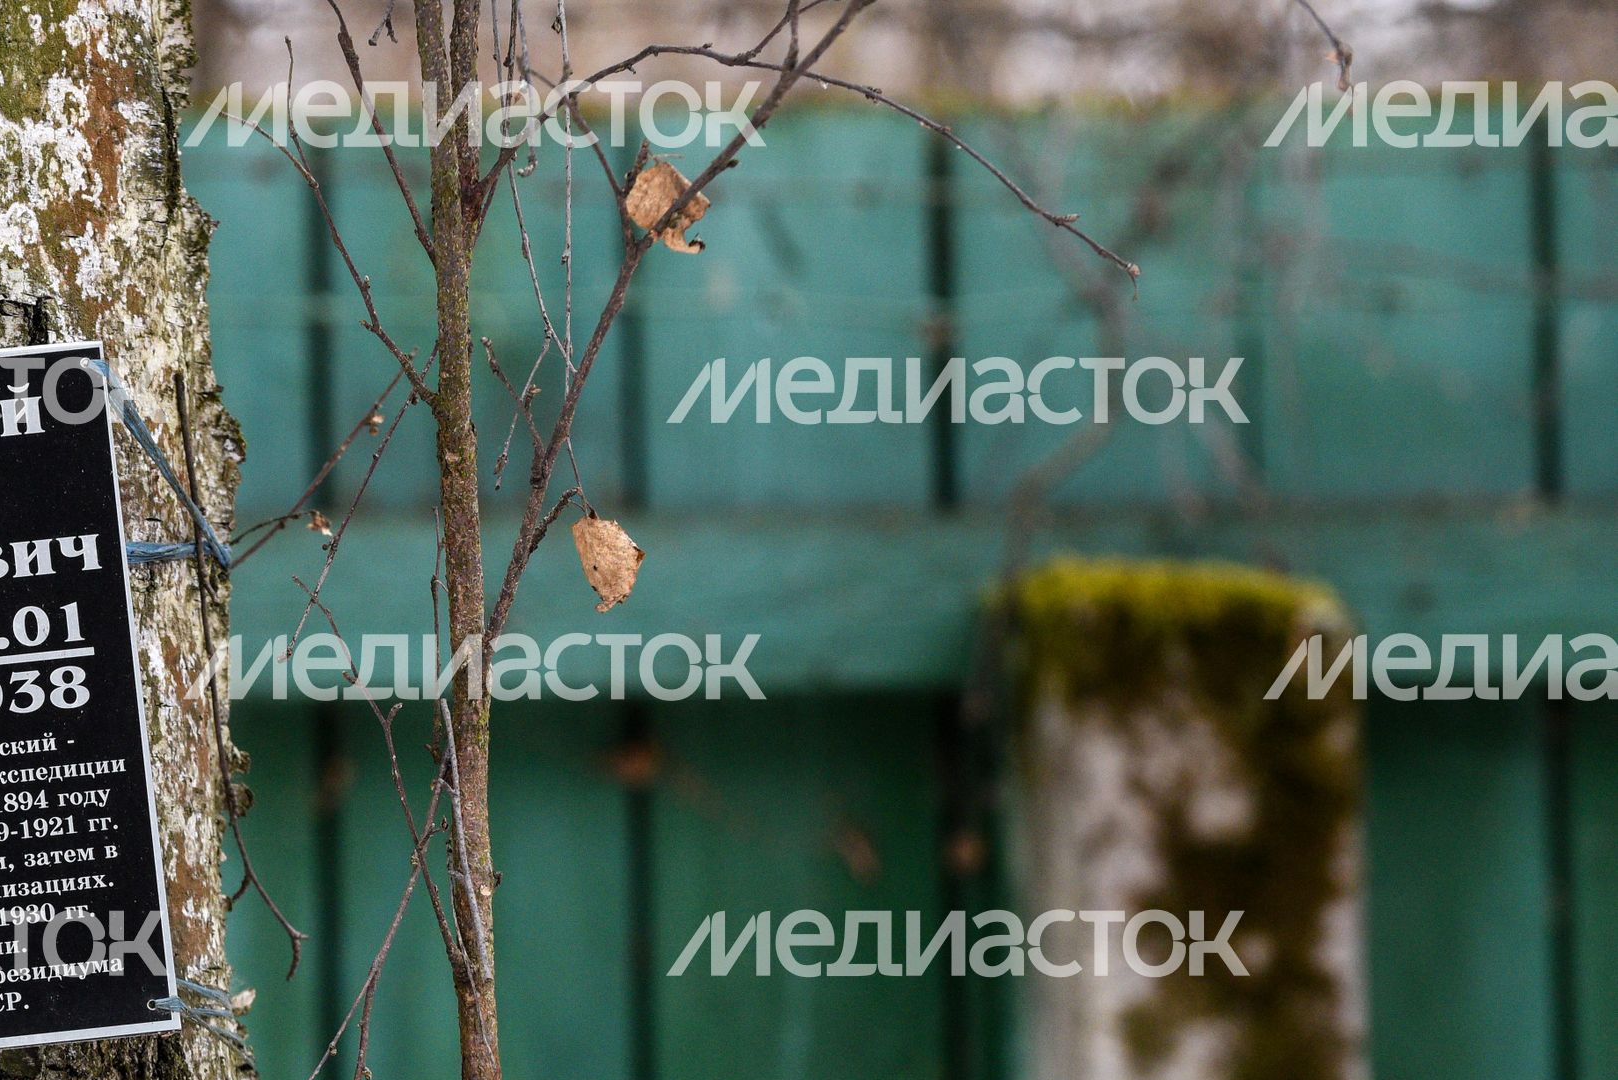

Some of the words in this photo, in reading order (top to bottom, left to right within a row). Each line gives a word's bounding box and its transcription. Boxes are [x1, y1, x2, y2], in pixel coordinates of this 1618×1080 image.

[57, 788, 111, 808] году
[87, 817, 119, 832] гг.
[24, 847, 95, 867] затем
[104, 845, 118, 859] в
[64, 904, 95, 920] гг.
